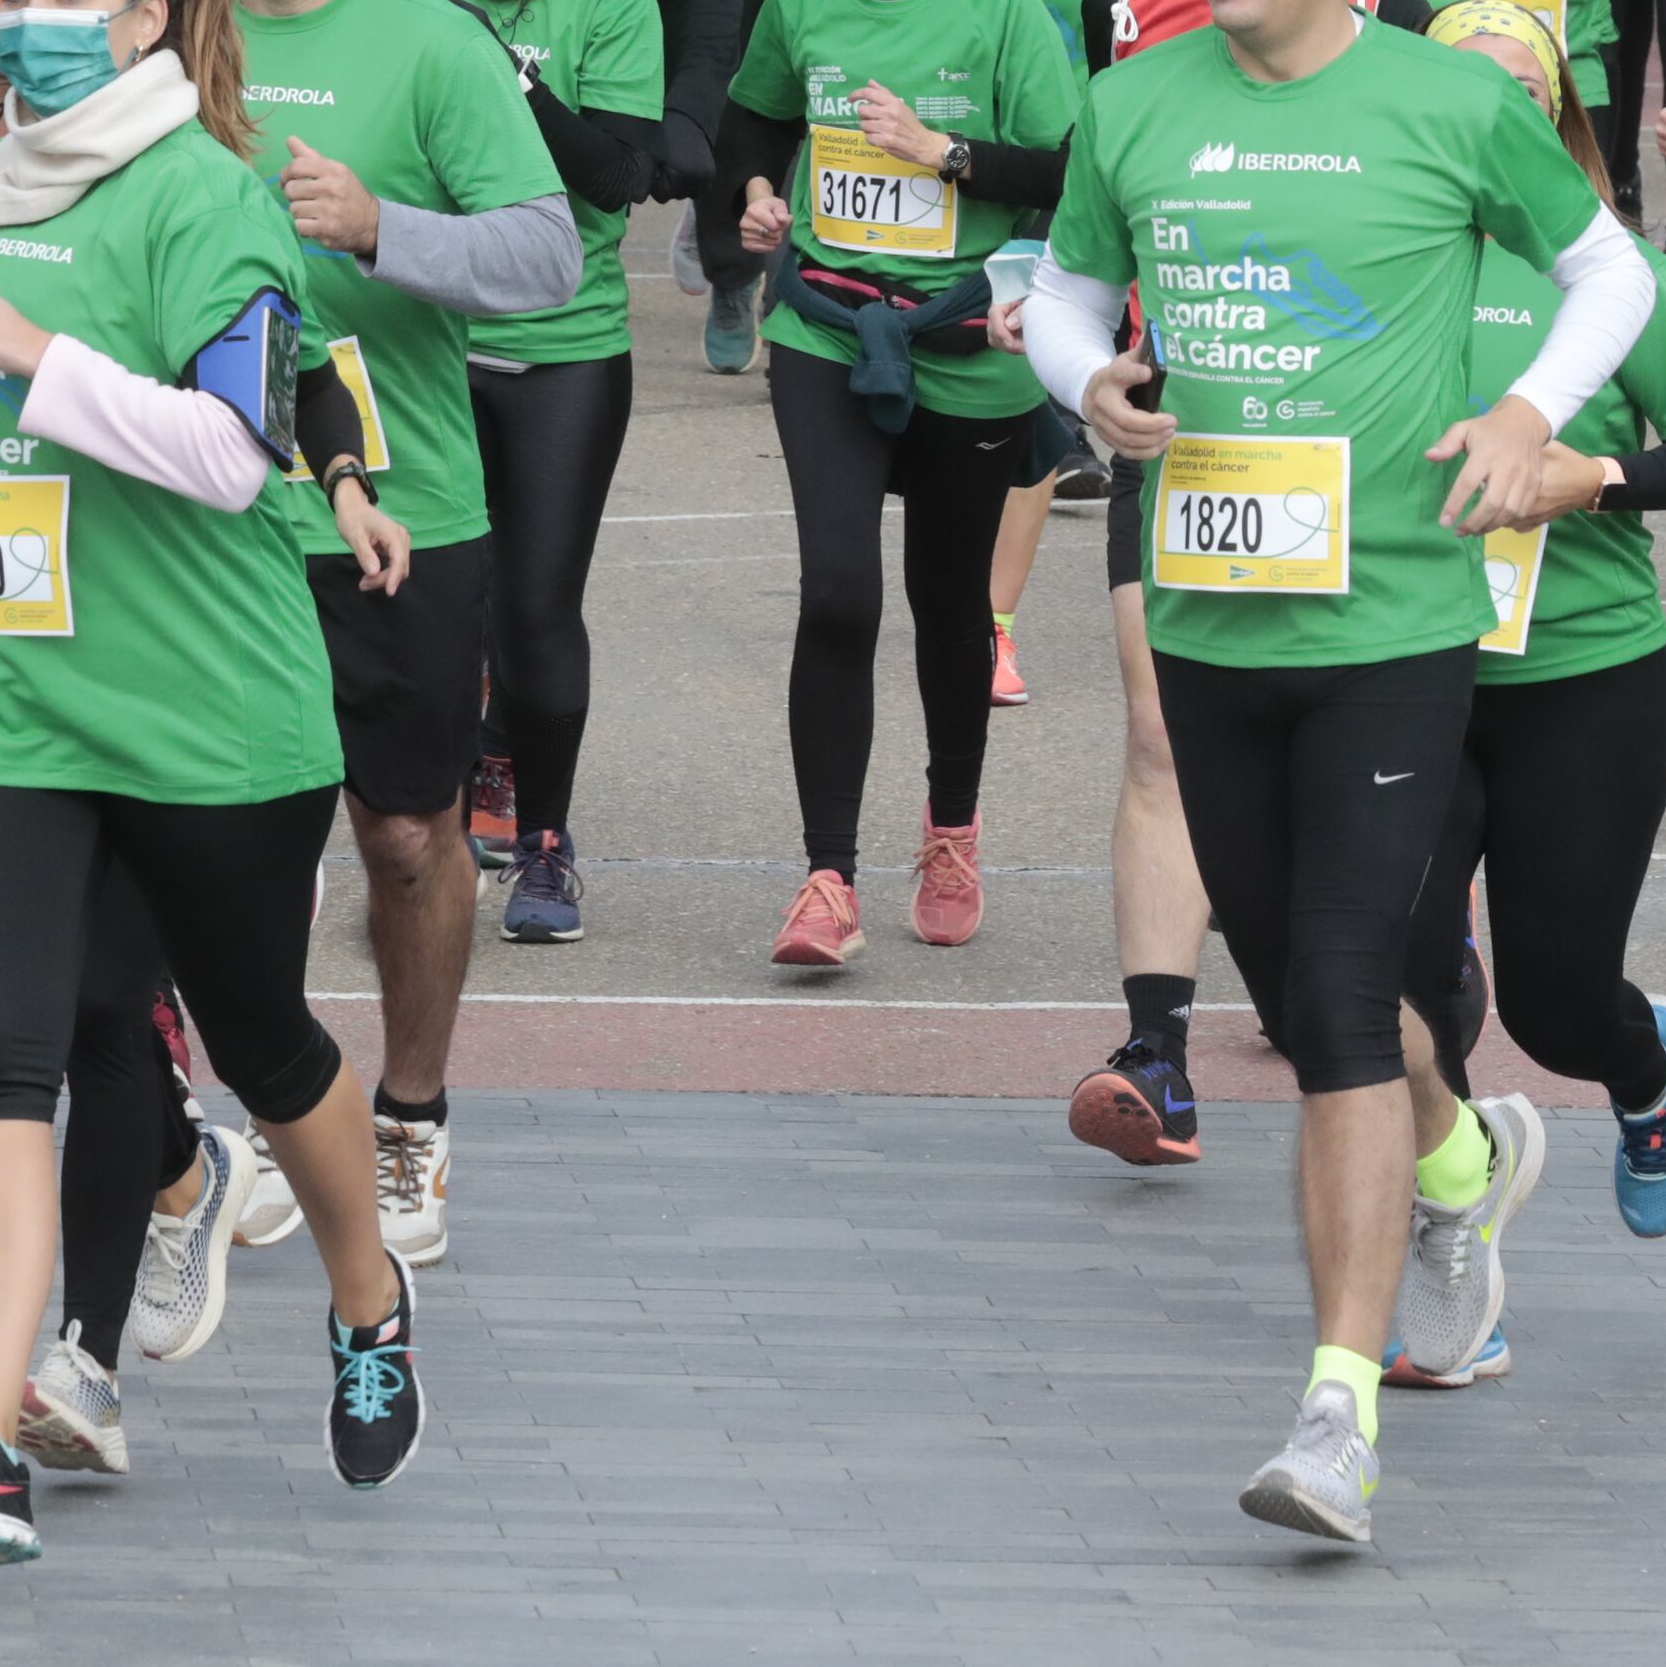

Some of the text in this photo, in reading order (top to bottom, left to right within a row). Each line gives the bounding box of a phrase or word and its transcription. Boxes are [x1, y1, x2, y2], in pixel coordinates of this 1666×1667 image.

[809, 82, 824, 96] EN
[817, 133, 859, 147] Valladolid
[1237, 152, 1362, 174] IBERDROLA
[822, 170, 902, 222] 31671
[1161, 199, 1252, 211] Edición Valladolid
[1151, 217, 1189, 251] En
[1157, 257, 1291, 292] marcha
[1164, 297, 1266, 331] contra
[1164, 333, 1321, 372] el cáncer
[1170, 459, 1250, 474] contra el cáncer
[1173, 445, 1283, 461] Valladolid en marcha
[1179, 494, 1263, 555] 1820
